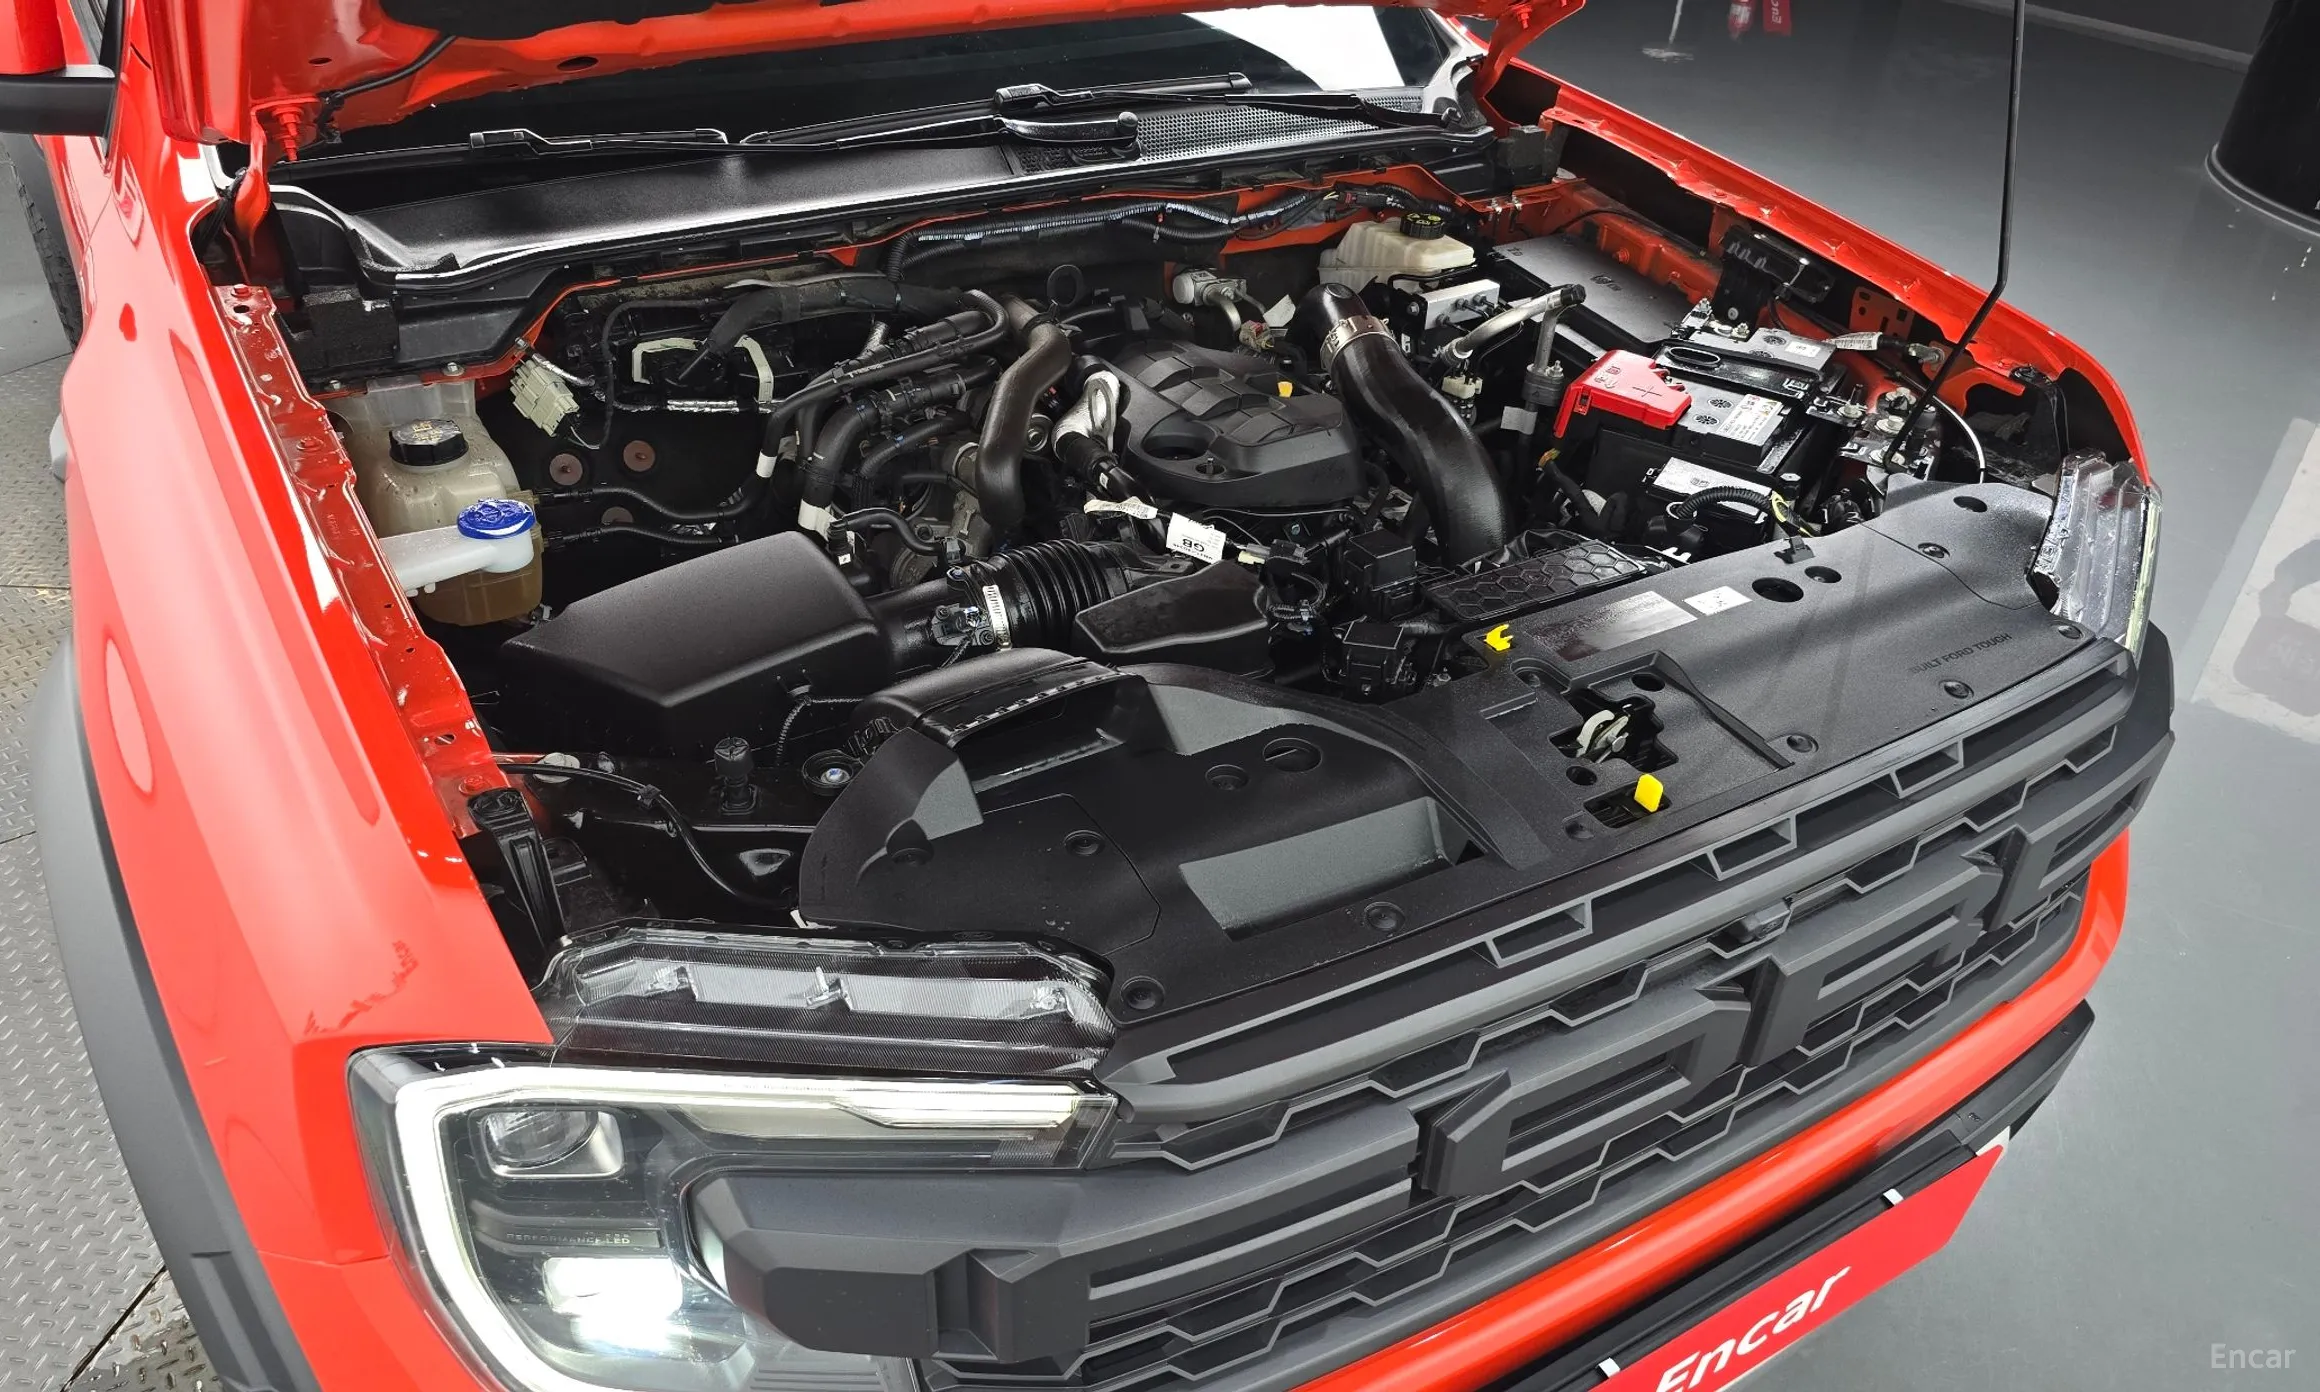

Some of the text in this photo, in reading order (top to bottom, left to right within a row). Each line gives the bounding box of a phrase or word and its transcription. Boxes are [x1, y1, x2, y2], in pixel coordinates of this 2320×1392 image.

[1909, 633, 2013, 674] BUILT FORD TOUGH
[605, 1235, 631, 1245] LED
[1655, 1266, 1851, 1392] Encar
